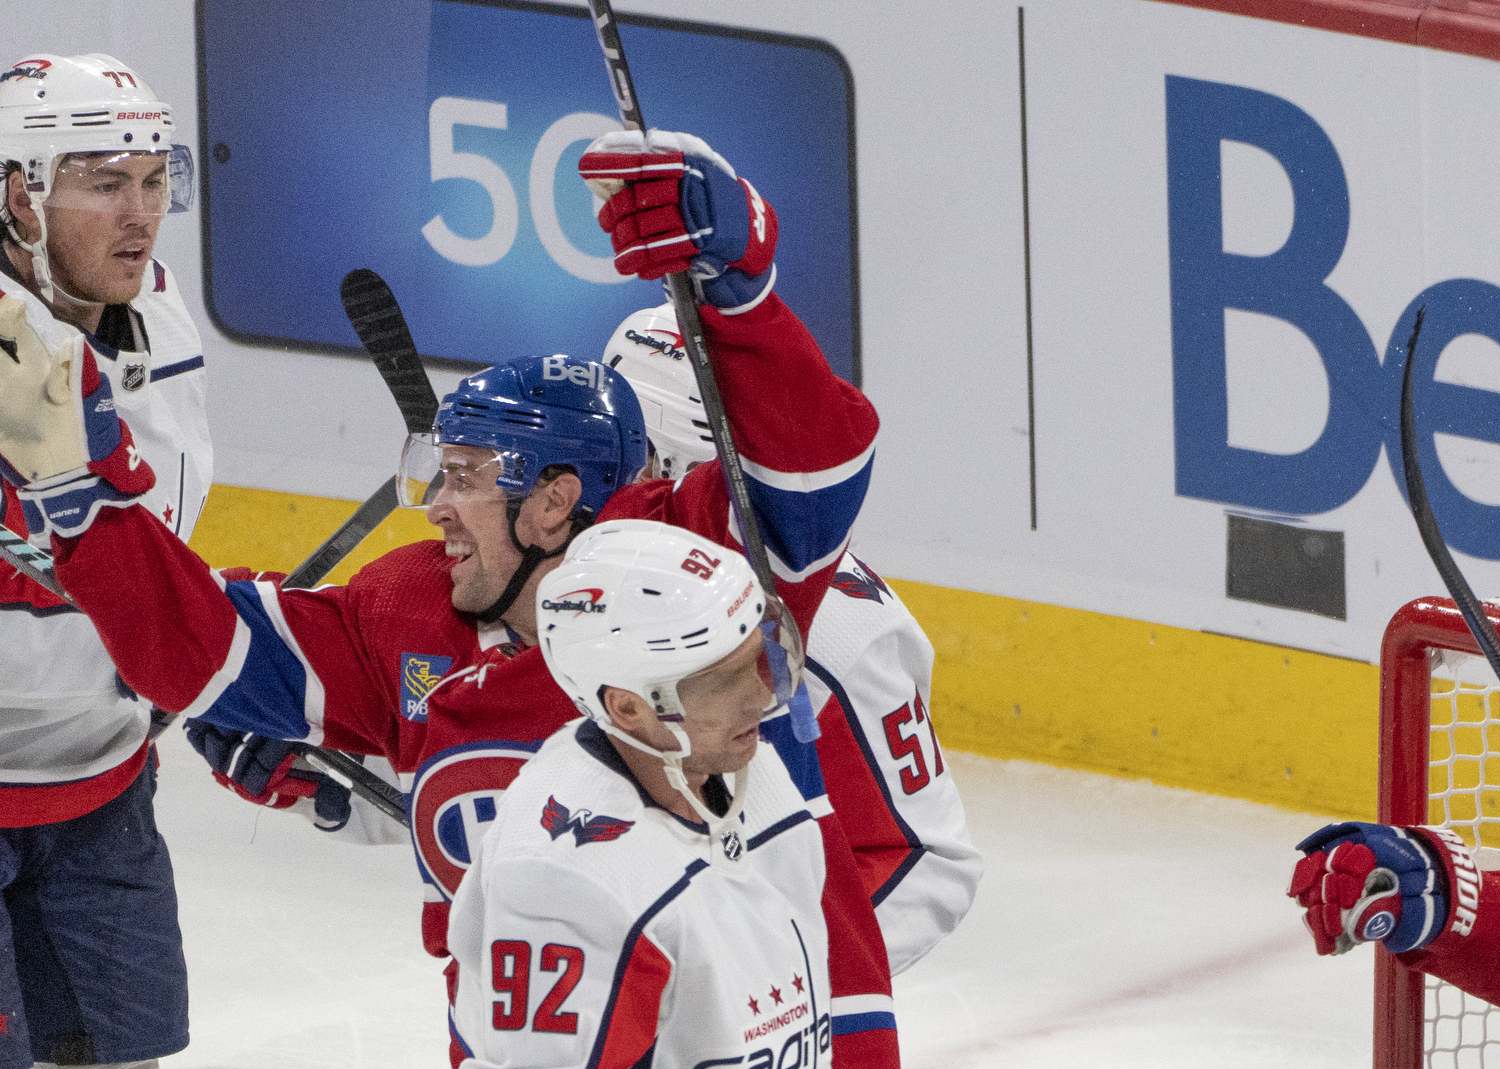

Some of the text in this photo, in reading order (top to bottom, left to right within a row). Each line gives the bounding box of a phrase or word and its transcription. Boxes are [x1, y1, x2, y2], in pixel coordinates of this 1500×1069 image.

[102, 71, 137, 88] 77
[116, 112, 161, 120] BAUER
[542, 356, 605, 390] Bell
[681, 548, 721, 580] 92
[490, 939, 585, 1035] 92
[744, 1002, 808, 1043] WASHINGTON
